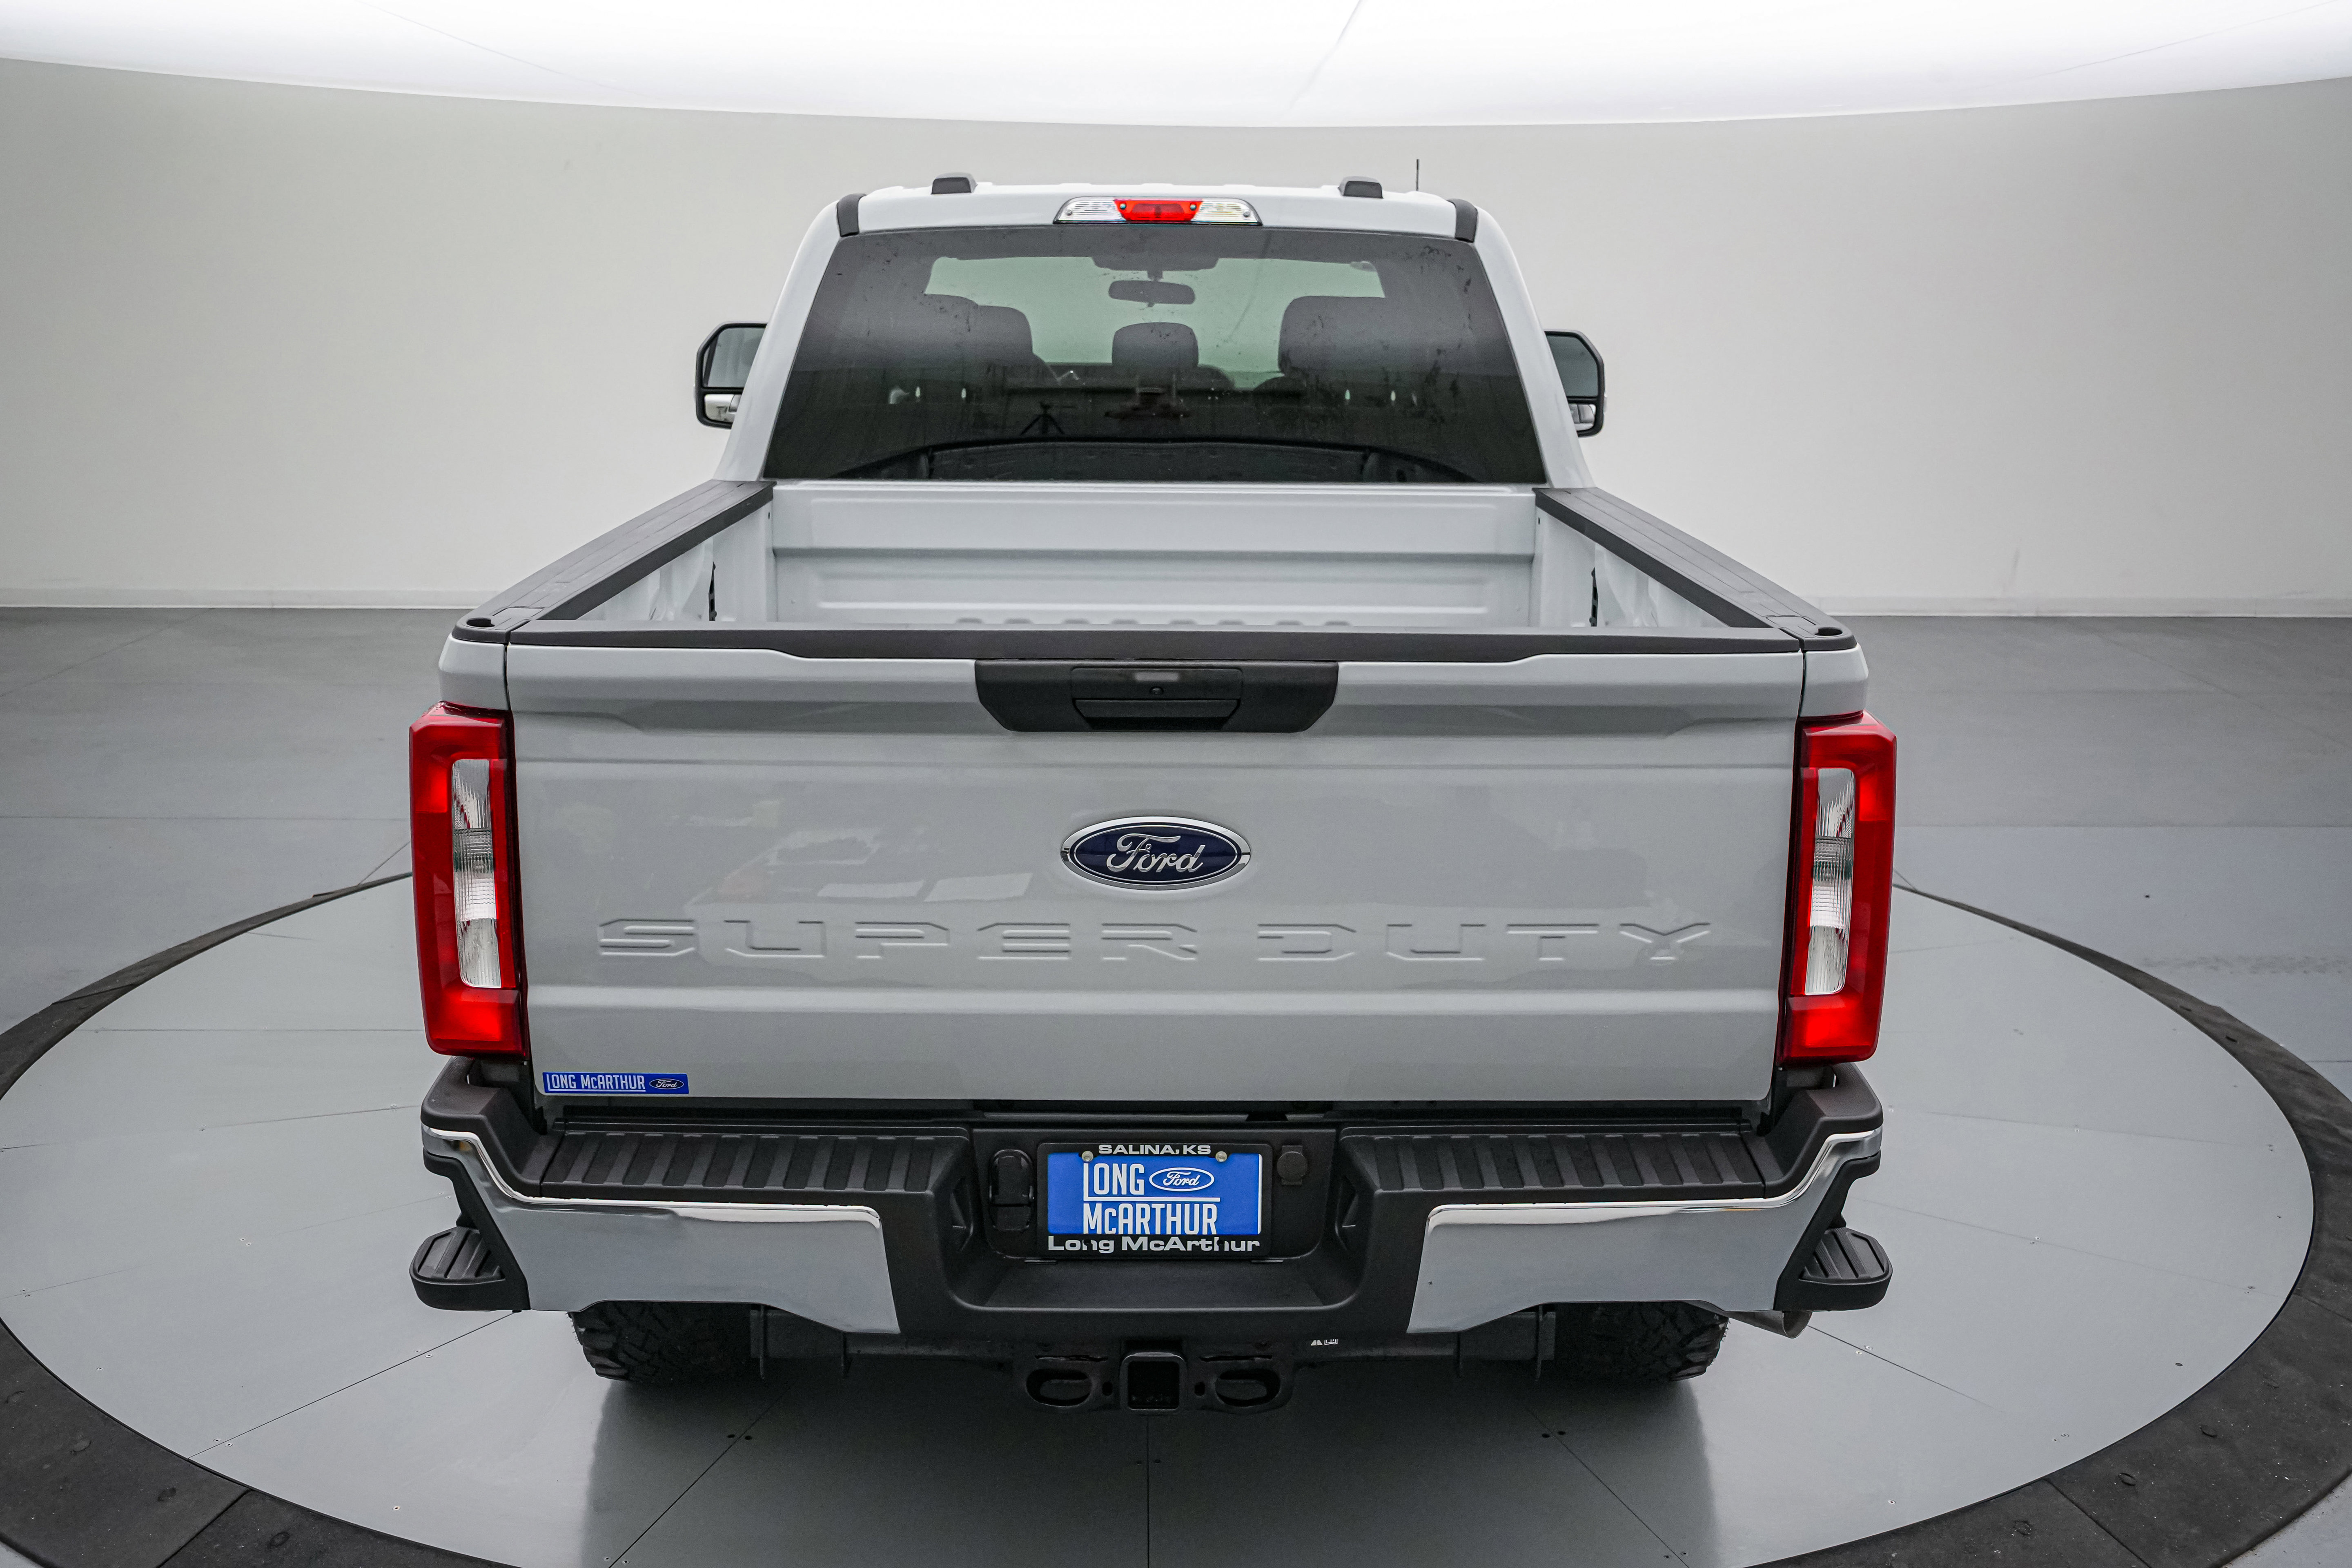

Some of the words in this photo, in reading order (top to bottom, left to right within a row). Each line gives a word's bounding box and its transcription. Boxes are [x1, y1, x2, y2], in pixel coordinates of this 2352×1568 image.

[1106, 833, 1206, 873] Ford
[598, 918, 1199, 960] SUPER
[1257, 922, 1712, 961] DUTY
[546, 1074, 577, 1090] LONG
[580, 1074, 646, 1090] McARTHUR
[655, 1079, 678, 1089] Ford
[1083, 1163, 1145, 1200] LONG
[1163, 1171, 1200, 1187] Ford
[1082, 1203, 1218, 1235] McARTHUR
[1048, 1236, 1115, 1254] Long
[1121, 1236, 1261, 1252] McArthur
